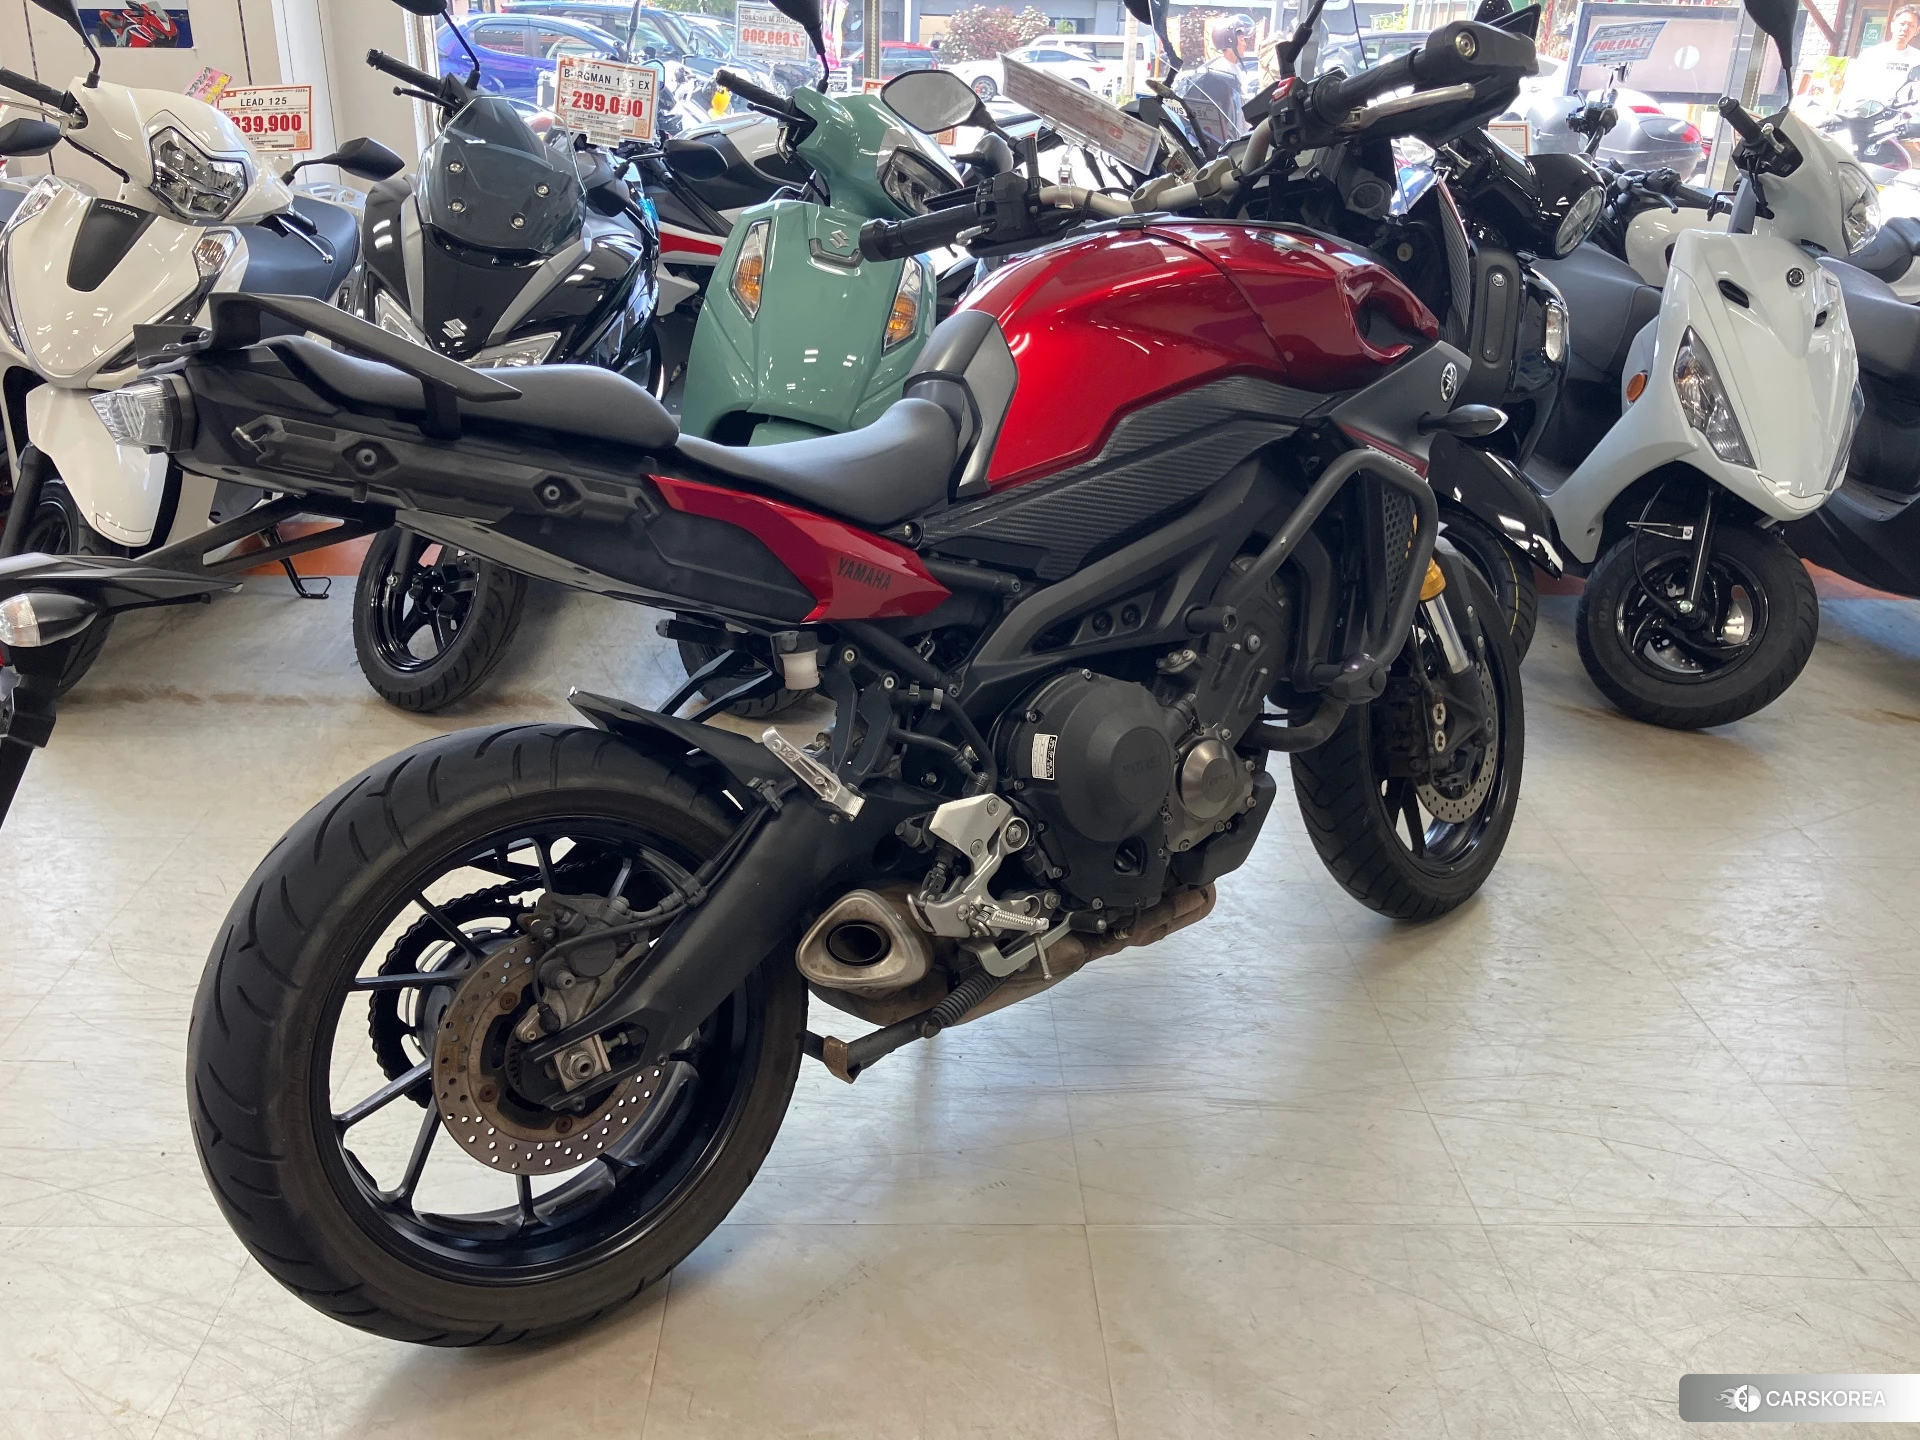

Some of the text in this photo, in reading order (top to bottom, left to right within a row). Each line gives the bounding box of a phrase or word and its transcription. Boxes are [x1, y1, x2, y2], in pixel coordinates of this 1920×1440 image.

[638, 80, 650, 91] EX
[240, 97, 287, 107] LEAD 125
[561, 97, 567, 106] ¥
[100, 203, 139, 219] HONDA
[837, 556, 892, 591] YAMAHA
